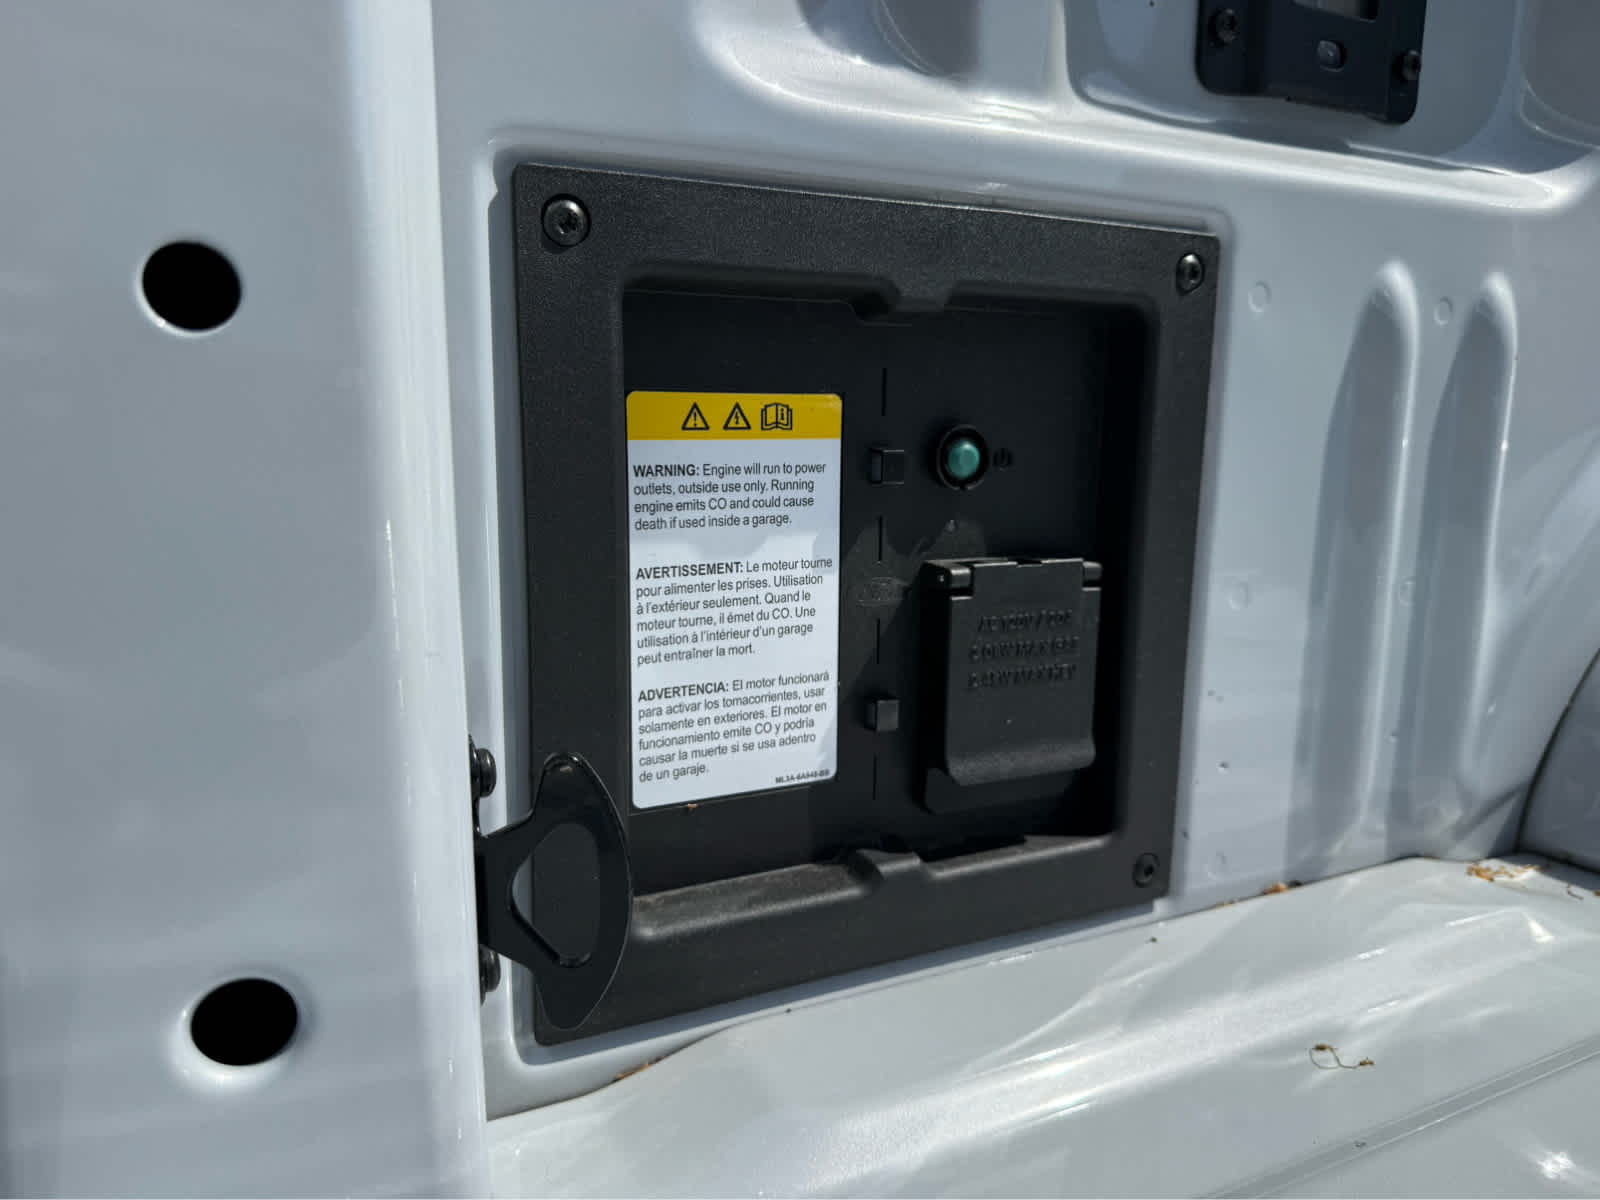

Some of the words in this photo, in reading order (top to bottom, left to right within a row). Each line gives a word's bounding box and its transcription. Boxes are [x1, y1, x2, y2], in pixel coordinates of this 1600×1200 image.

[633, 464, 700, 478] WARNING:
[702, 464, 742, 479] Engine
[744, 462, 760, 475] will
[763, 464, 780, 474] run
[783, 463, 792, 474] to
[794, 464, 826, 477] power
[634, 482, 676, 496] outlets,
[678, 481, 719, 495] outside
[721, 483, 741, 493] use
[743, 480, 769, 495] only.
[771, 478, 814, 493] Running
[634, 500, 674, 516] engine
[675, 499, 706, 512] emits
[708, 497, 727, 510] CO
[729, 496, 751, 510] and
[752, 495, 781, 509] could
[782, 496, 814, 508] cause
[634, 517, 668, 531] death
[670, 516, 678, 528] if
[679, 515, 706, 528] used
[708, 513, 741, 527] inside
[742, 516, 750, 526] a
[751, 513, 792, 528] garage.
[635, 561, 744, 580] AVERTISSEMENT:
[746, 560, 760, 573] Le
[762, 560, 799, 572] moteur
[800, 558, 832, 569] tourne
[636, 586, 662, 600] pour
[664, 581, 716, 596] alimenter
[717, 578, 734, 592] les
[736, 577, 772, 593] prises.
[774, 573, 823, 588] Utilisation
[636, 602, 644, 615] à
[702, 594, 762, 609] seulement.
[764, 591, 800, 606] Quand
[802, 590, 811, 602] le
[636, 618, 676, 632] moteur
[678, 616, 717, 628] tourne,
[719, 612, 724, 624] il
[726, 611, 754, 624] émet
[756, 609, 770, 622] du
[772, 607, 792, 620] CO.
[795, 606, 816, 618] Une
[637, 633, 689, 648] utilisation
[691, 632, 698, 643] à
[777, 624, 813, 638] garage
[637, 651, 662, 667] peut
[664, 647, 714, 662] entraîner
[716, 646, 726, 656] la
[727, 643, 755, 656] mort.
[638, 681, 730, 703] ADVERTENCIA:
[732, 680, 743, 690] El
[746, 678, 776, 690] motor
[778, 670, 829, 686] funcionará
[638, 706, 663, 721] para
[665, 702, 702, 715] activar
[704, 698, 720, 711] los
[722, 691, 802, 709] tomacorrientes,
[804, 688, 825, 698] usar
[638, 718, 695, 735] solamente
[697, 716, 711, 726] en
[714, 710, 769, 725] exteriores.
[771, 705, 782, 718] El
[784, 703, 812, 716] motor
[814, 702, 827, 712] en
[638, 730, 721, 752] funcionamiento
[723, 726, 752, 738] emite
[754, 721, 772, 734] CO
[774, 723, 781, 735] y
[639, 753, 676, 767] causar
[678, 750, 688, 760] la
[691, 744, 728, 759] muerte
[730, 742, 740, 752] si
[742, 742, 754, 752] se
[758, 739, 776, 750] usa
[779, 732, 816, 746] adentro
[639, 770, 653, 783] de
[656, 770, 670, 779] un
[672, 762, 708, 780] garaje.
